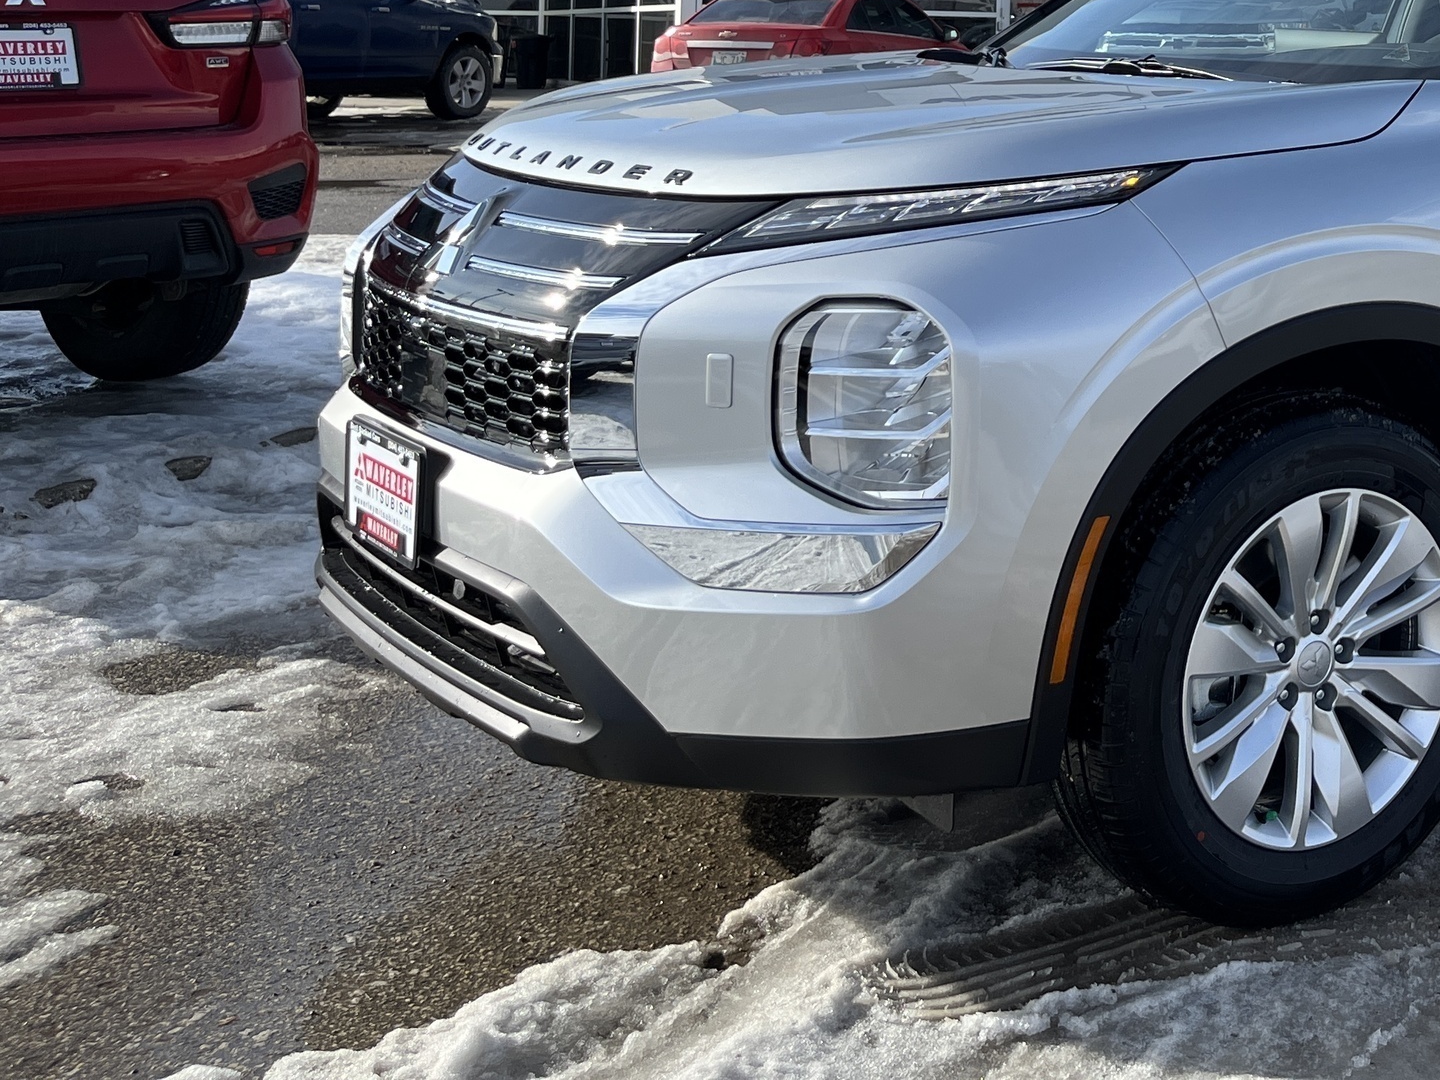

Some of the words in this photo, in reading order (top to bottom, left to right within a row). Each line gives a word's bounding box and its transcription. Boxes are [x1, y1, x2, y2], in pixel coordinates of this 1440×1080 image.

[0, 56, 67, 65] TSUBISHI
[467, 133, 694, 186] OUTLANDER
[365, 458, 413, 503] WAVERLEY
[366, 483, 413, 520] MITSUBISHI
[367, 516, 399, 549] WAVERLEY
